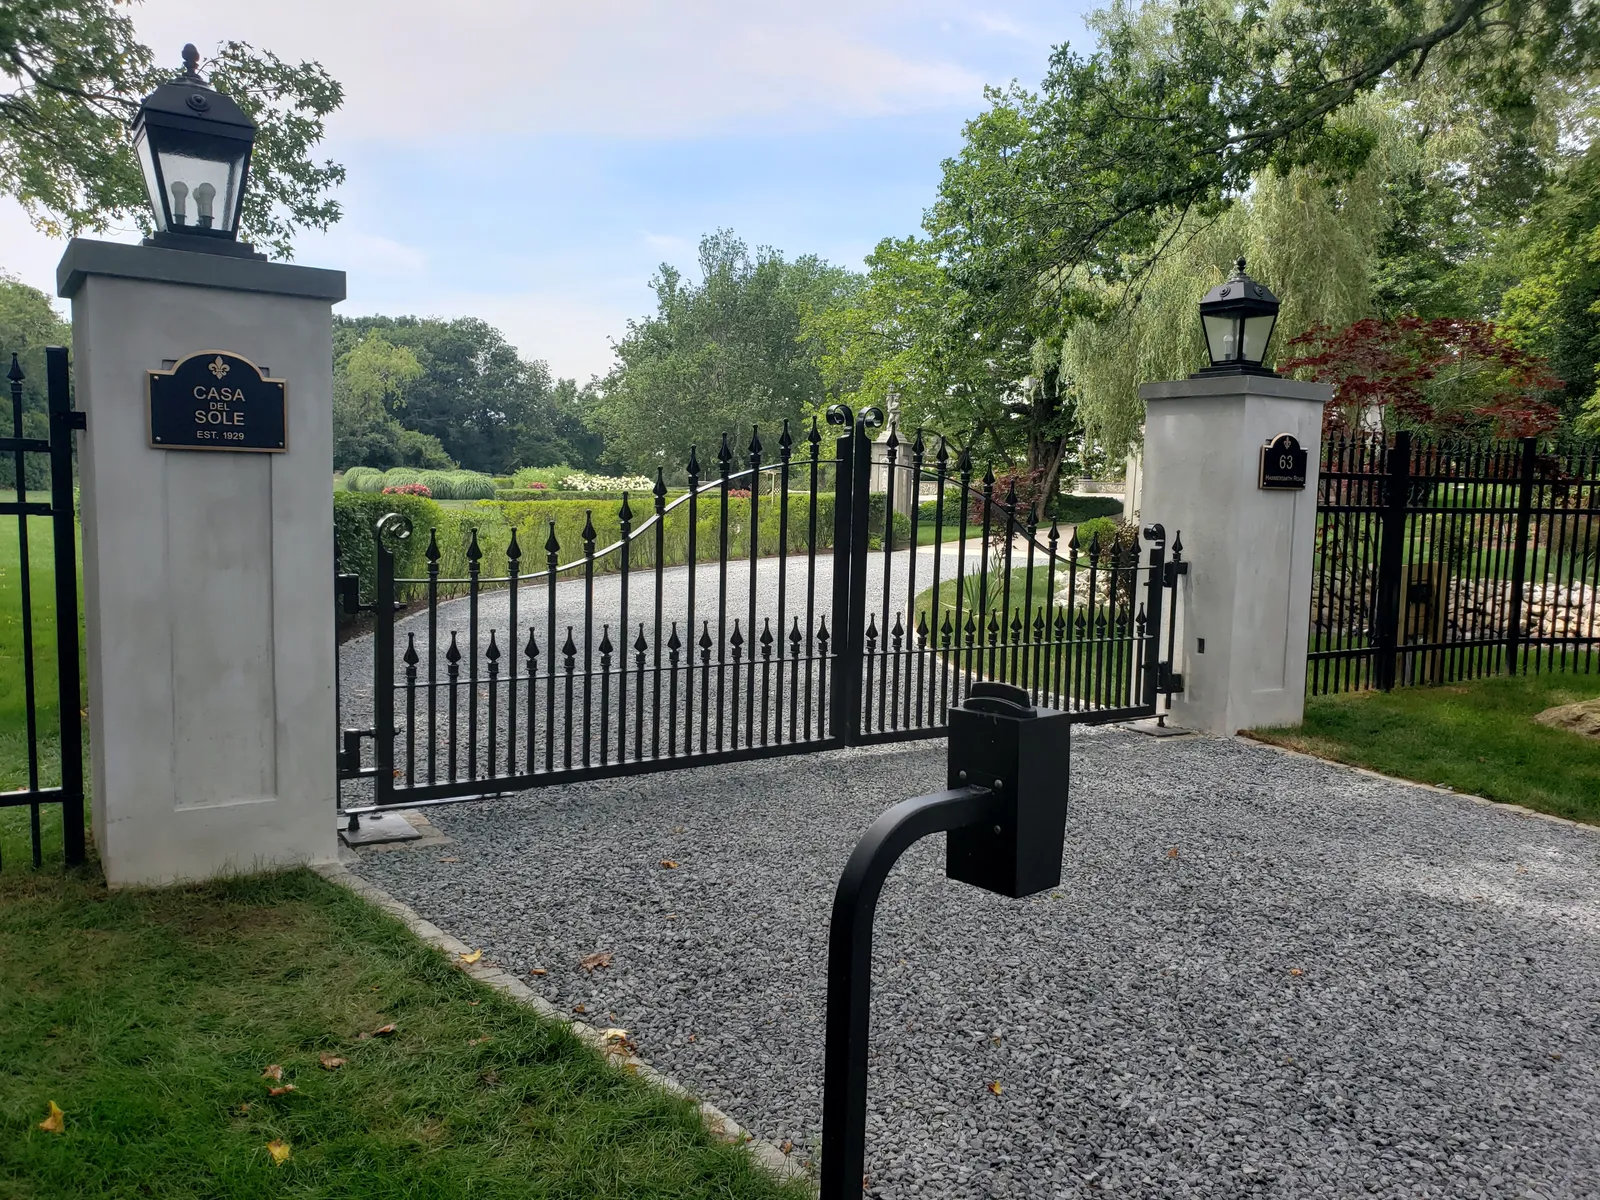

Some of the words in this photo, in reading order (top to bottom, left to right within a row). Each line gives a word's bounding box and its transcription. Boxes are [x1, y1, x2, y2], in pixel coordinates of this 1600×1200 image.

[194, 386, 246, 402] CASA
[210, 402, 230, 410] DEL
[194, 410, 245, 426] SOLE
[196, 430, 219, 439] EST.
[222, 432, 244, 440] 1929
[1280, 455, 1293, 469] 63
